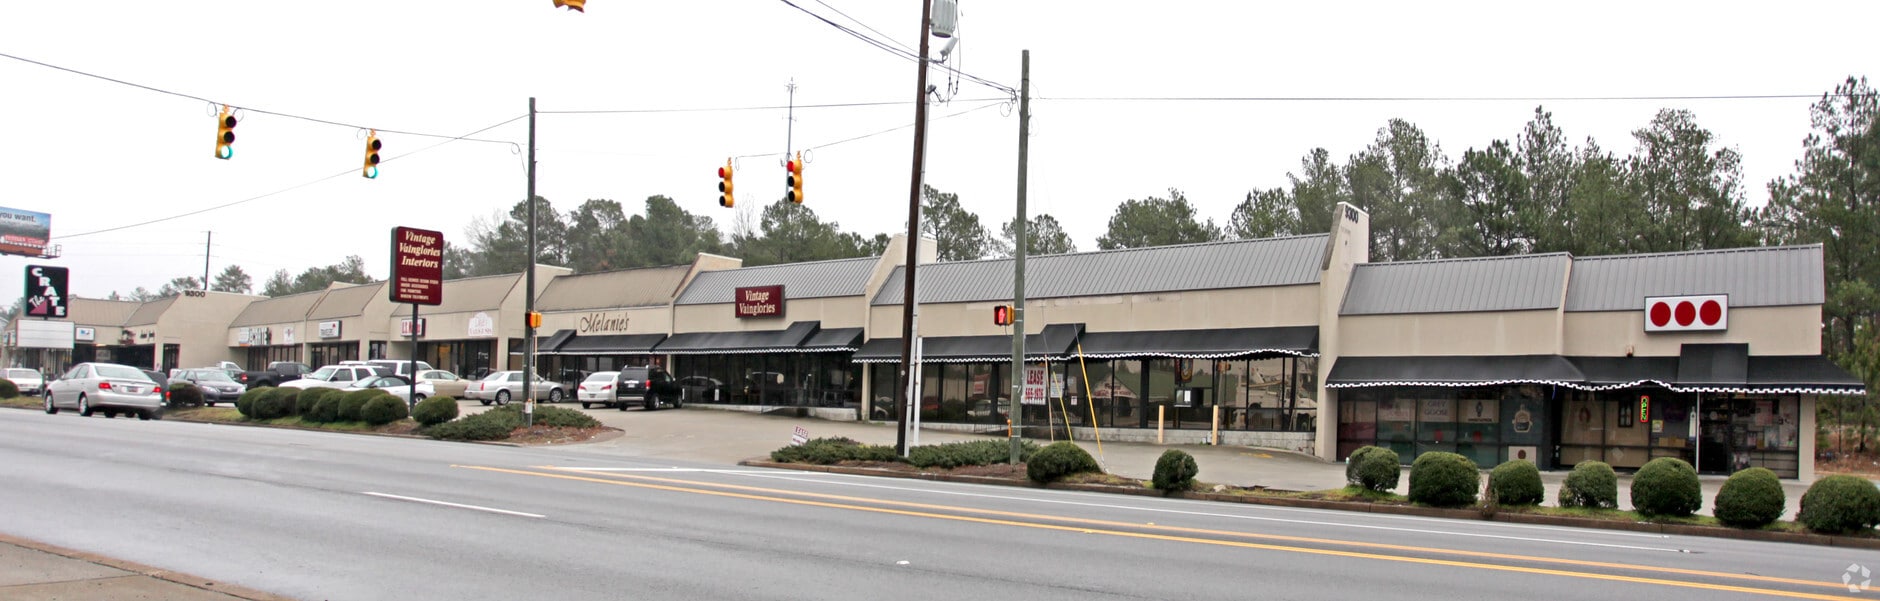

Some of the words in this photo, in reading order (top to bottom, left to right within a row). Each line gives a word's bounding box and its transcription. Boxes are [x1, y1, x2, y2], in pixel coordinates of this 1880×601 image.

[14, 214, 36, 222] want.
[405, 230, 436, 246] Vintage
[400, 242, 441, 257] Vainglories
[401, 255, 438, 268] Interiors
[31, 267, 65, 316] CRATE
[745, 290, 770, 303] Vintage
[739, 302, 776, 316] Vainglories
[580, 312, 630, 333] Melanie's
[1027, 370, 1044, 385] LEASE
